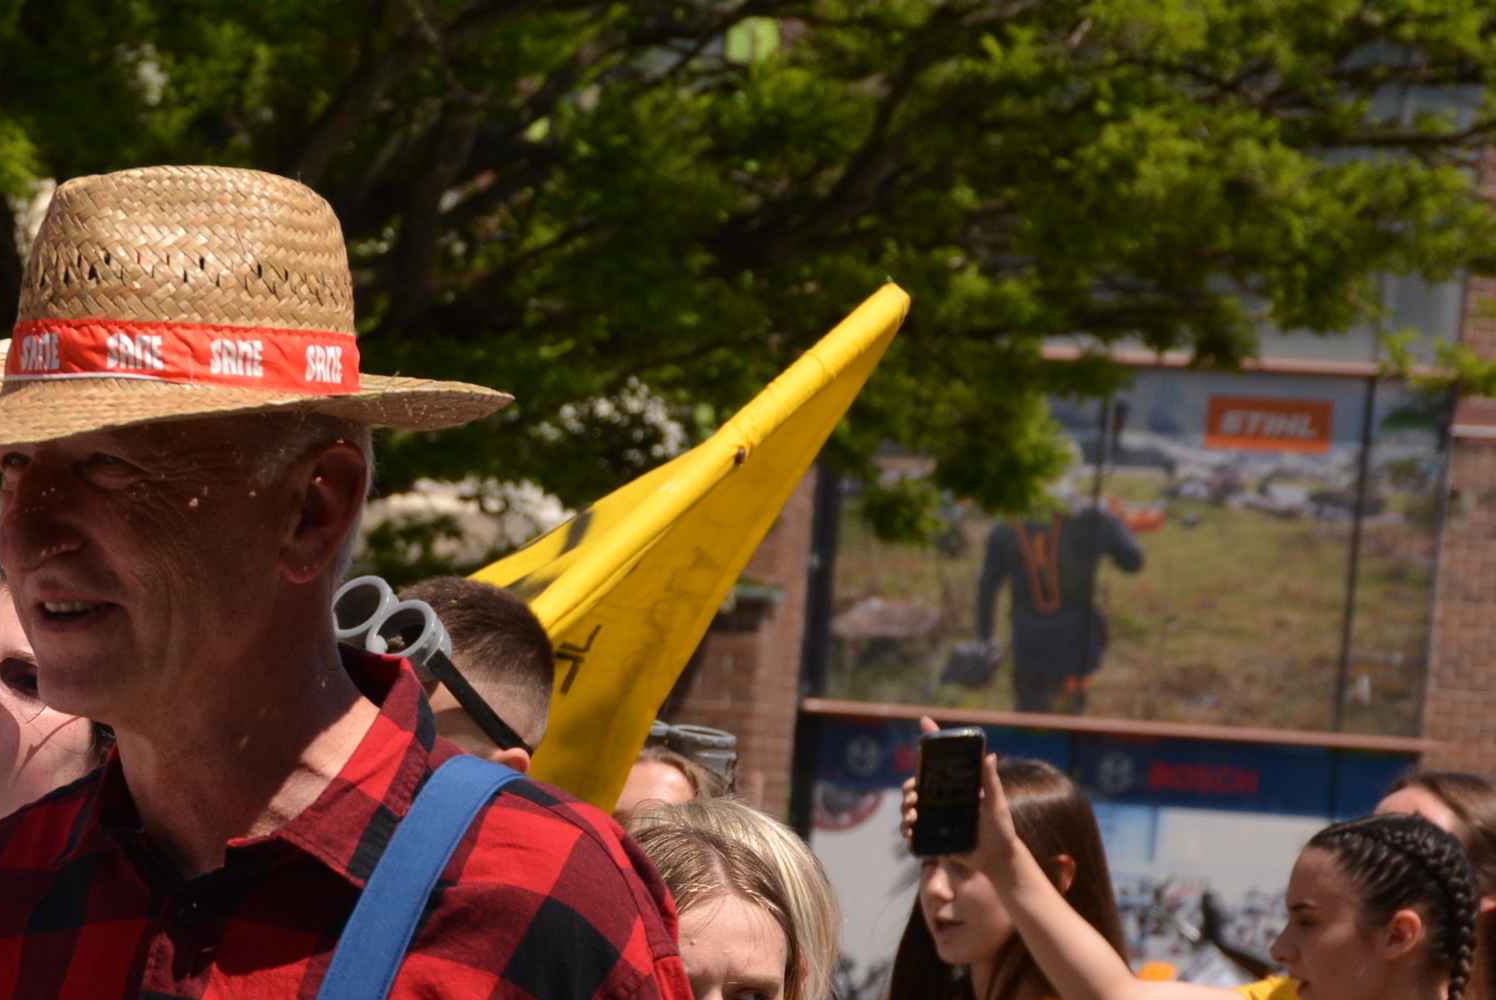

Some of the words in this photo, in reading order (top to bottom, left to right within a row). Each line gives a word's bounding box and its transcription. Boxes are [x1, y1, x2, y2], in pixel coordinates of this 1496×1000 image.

[106, 333, 164, 371] SAME
[209, 338, 264, 378] SAME
[305, 344, 343, 385] SAME
[1221, 409, 1318, 439] STIHL
